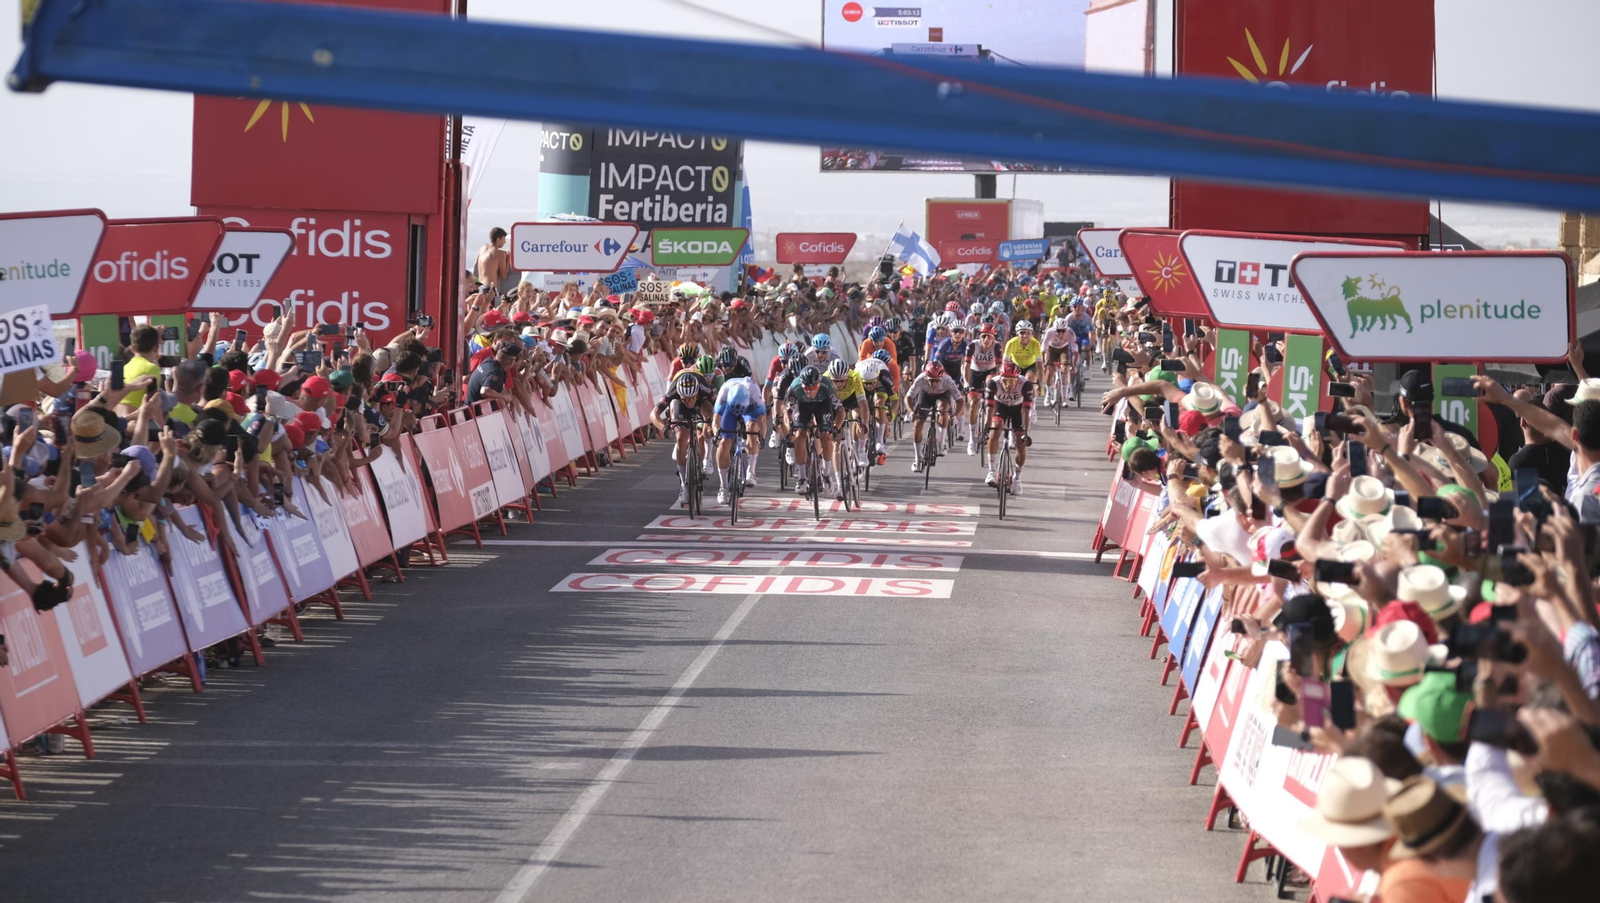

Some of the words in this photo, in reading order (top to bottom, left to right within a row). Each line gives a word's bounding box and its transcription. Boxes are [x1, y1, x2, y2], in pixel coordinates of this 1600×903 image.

[911, 45, 946, 53] Carrefour
[598, 194, 728, 223] Fertiberia
[521, 240, 588, 253] Carrefour
[658, 238, 734, 254] ŠKODA
[799, 241, 846, 253] Cofidis
[957, 247, 992, 256] Cofidis
[206, 252, 261, 275] OT
[237, 279, 261, 288] 1853
[605, 270, 628, 288] SOS
[639, 281, 663, 293] SOS
[1212, 288, 1252, 300] SWISS
[1420, 298, 1542, 324] plenitude
[975, 352, 993, 362] UAE
[659, 516, 961, 534] COFIDIS
[605, 549, 943, 569] COFIDIS
[567, 573, 934, 596] COFIDIS
